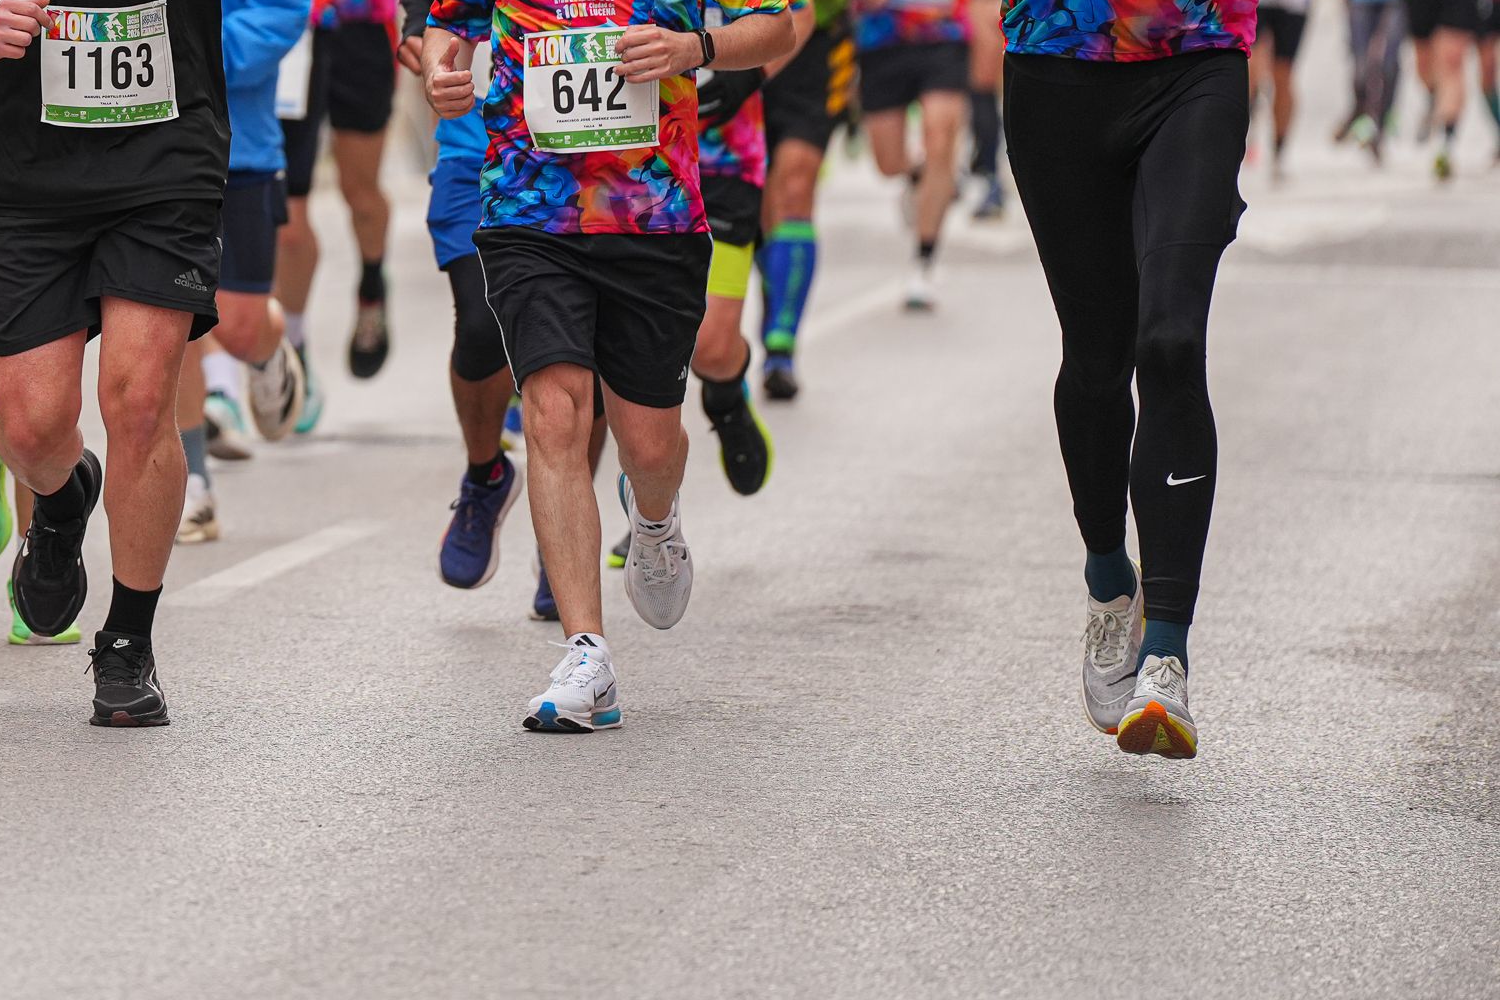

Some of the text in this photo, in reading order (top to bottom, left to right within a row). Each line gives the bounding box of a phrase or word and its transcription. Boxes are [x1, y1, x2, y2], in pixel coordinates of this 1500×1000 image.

[563, 2, 589, 19] 10K
[589, 7, 616, 17] LUCENA
[54, 12, 95, 41] 10K
[535, 35, 575, 65] 10K
[62, 43, 154, 90] 1163
[552, 66, 627, 114] 642
[174, 278, 208, 292] adidas
